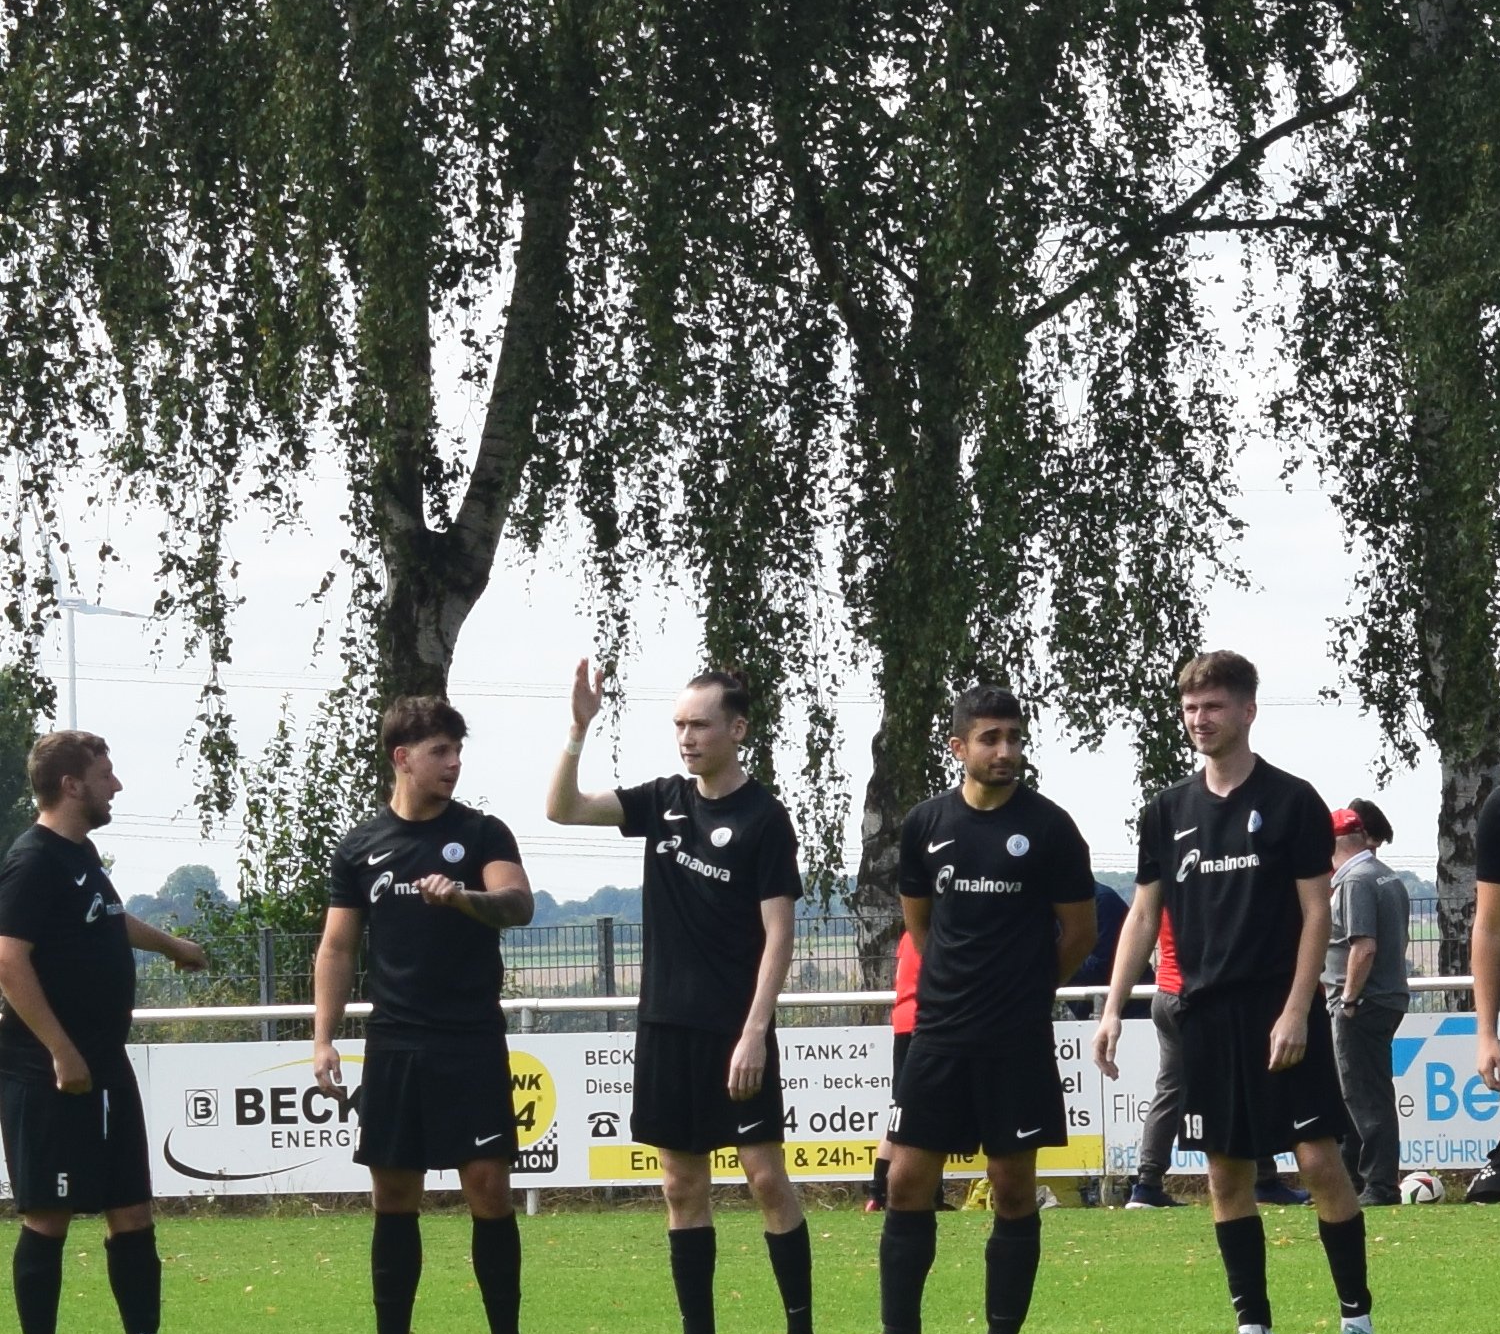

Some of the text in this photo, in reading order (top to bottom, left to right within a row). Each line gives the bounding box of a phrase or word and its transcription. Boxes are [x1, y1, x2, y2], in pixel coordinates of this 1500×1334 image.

[954, 876, 1023, 893] mainova
[795, 1044, 843, 1060] TANK
[586, 1078, 632, 1094] Diese
[823, 1073, 890, 1089] beck-en
[809, 1104, 879, 1133] oder
[1184, 1113, 1204, 1140] 19
[271, 1129, 351, 1149] ENERG
[794, 1148, 808, 1167] &
[817, 1146, 877, 1167] 24h-T
[57, 1172, 69, 1198] 5
